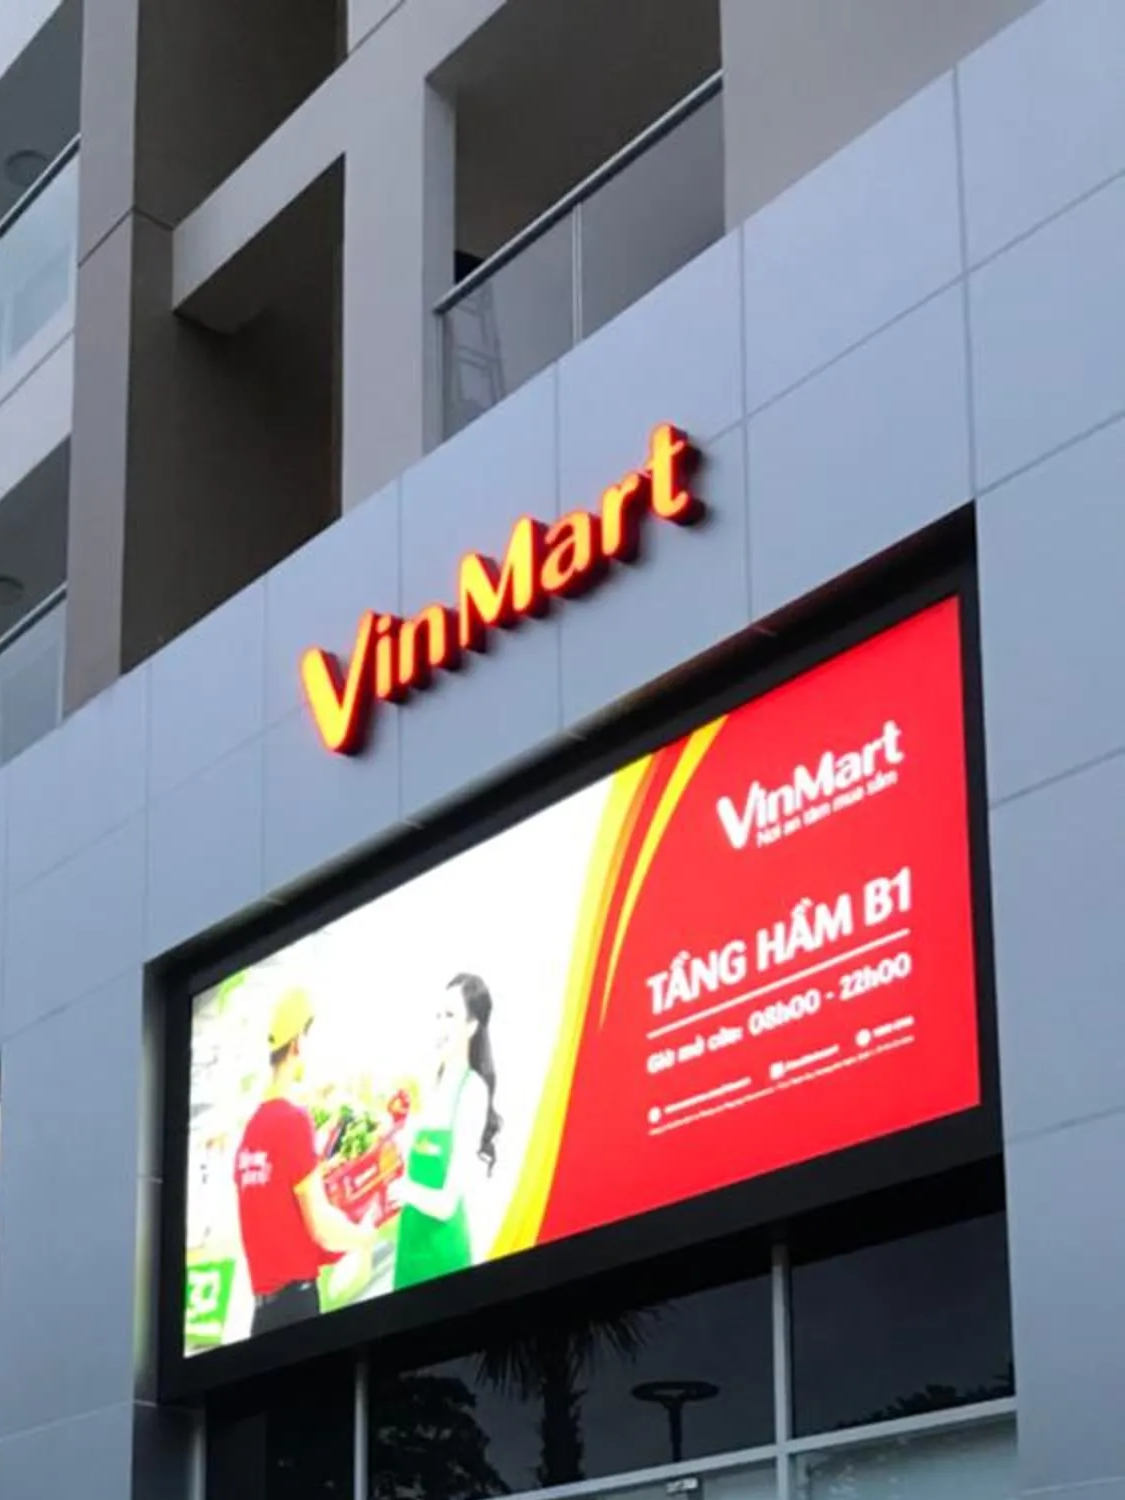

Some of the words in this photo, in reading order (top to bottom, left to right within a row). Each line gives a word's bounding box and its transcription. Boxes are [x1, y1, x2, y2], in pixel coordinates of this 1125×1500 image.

[299, 420, 699, 754] VinMart
[716, 720, 905, 849] VinMart
[864, 867, 911, 927] B1
